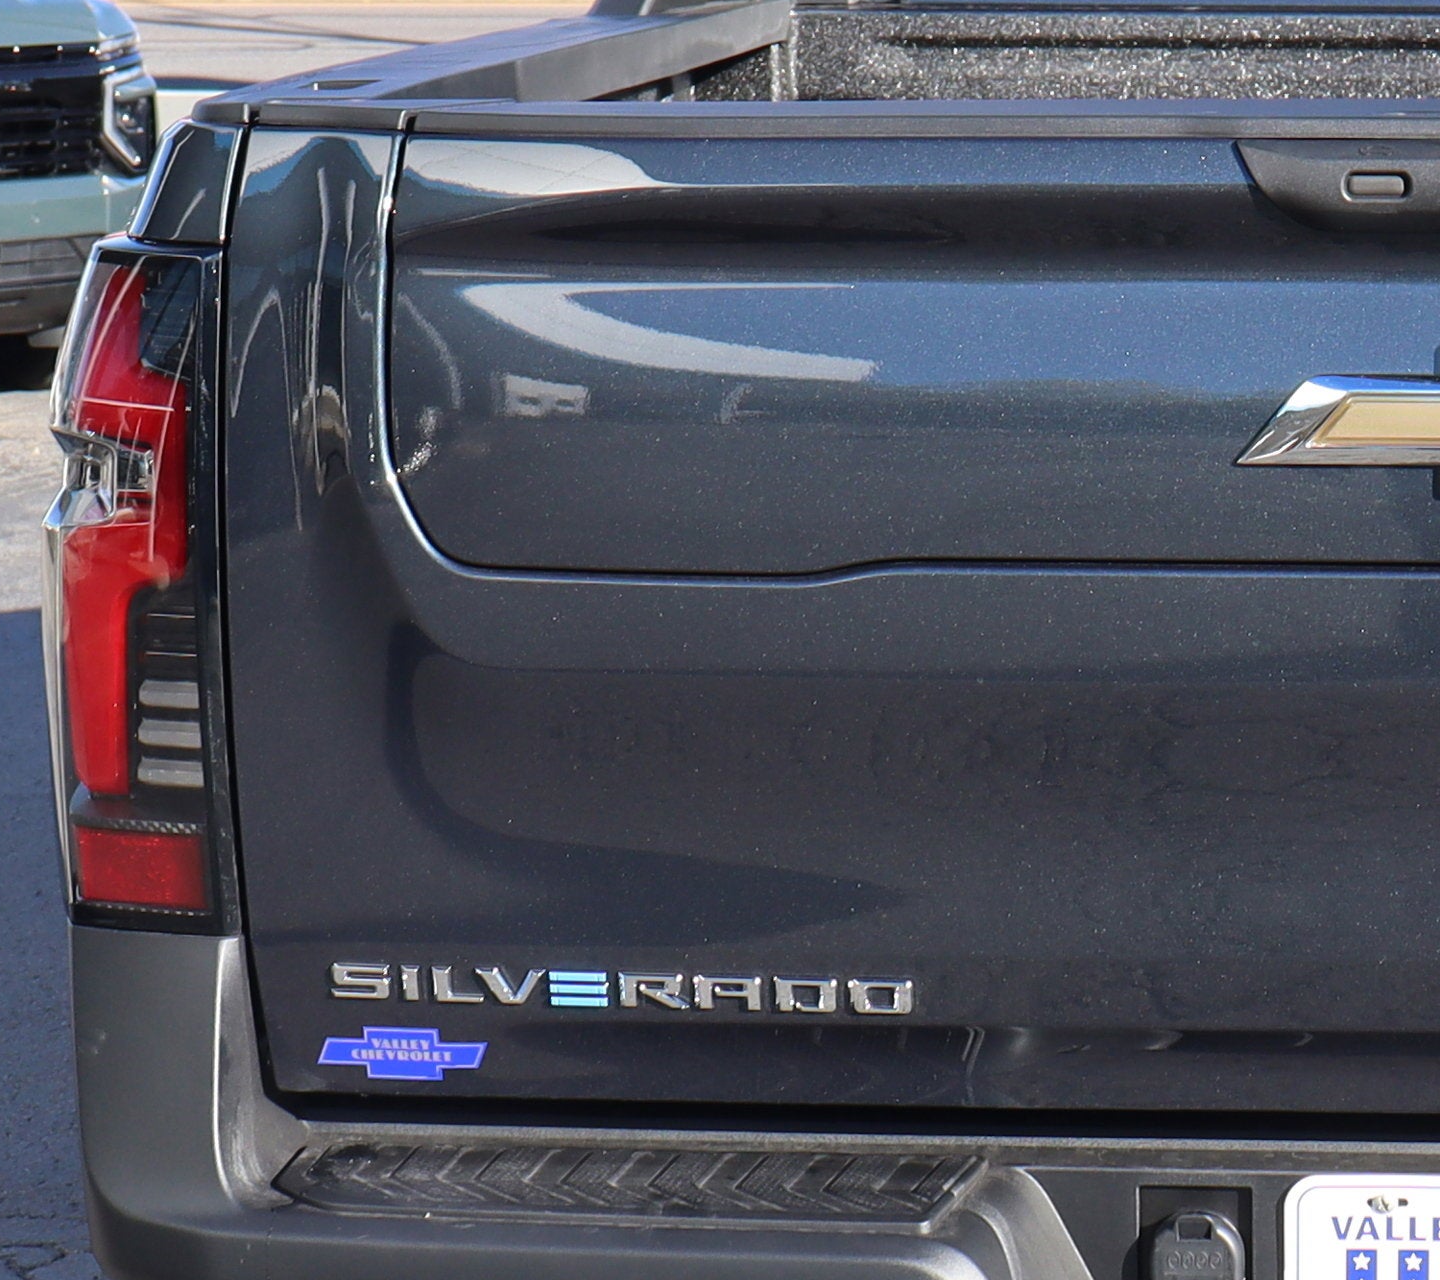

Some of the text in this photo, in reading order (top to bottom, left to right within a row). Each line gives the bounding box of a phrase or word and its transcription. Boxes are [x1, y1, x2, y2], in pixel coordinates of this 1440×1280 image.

[328, 961, 915, 1015] SILVERADO
[371, 1038, 431, 1050] VALLEY
[351, 1048, 452, 1062] CHEVROLET
